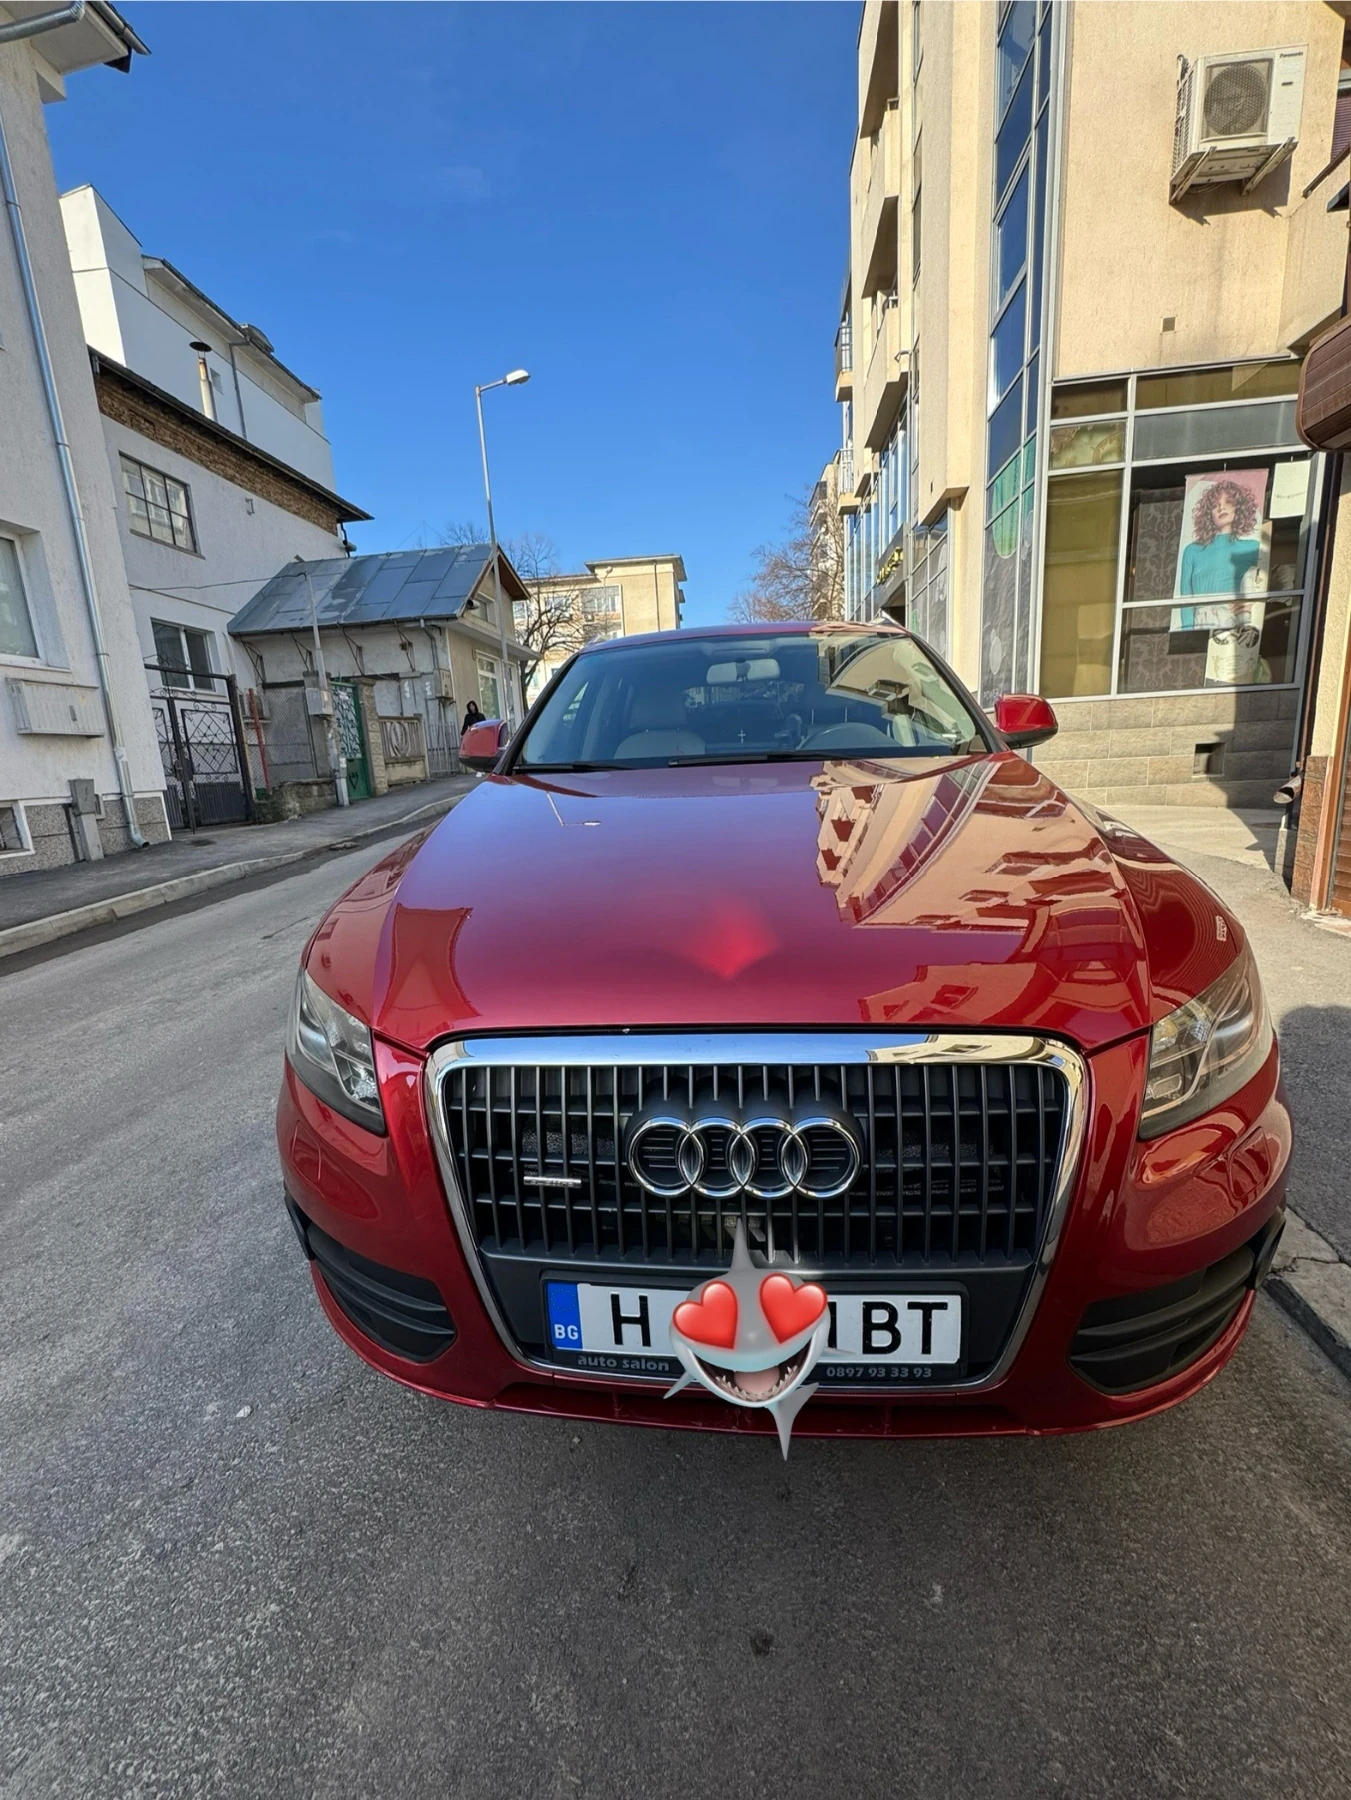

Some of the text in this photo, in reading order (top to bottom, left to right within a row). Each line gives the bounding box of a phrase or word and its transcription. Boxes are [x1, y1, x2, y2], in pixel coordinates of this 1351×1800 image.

[554, 1324, 579, 1340] BG
[610, 1293, 651, 1347] H
[862, 1301, 948, 1355] BT
[577, 1355, 669, 1371] auto salon
[826, 1367, 932, 1377] 0897 93 33 93
